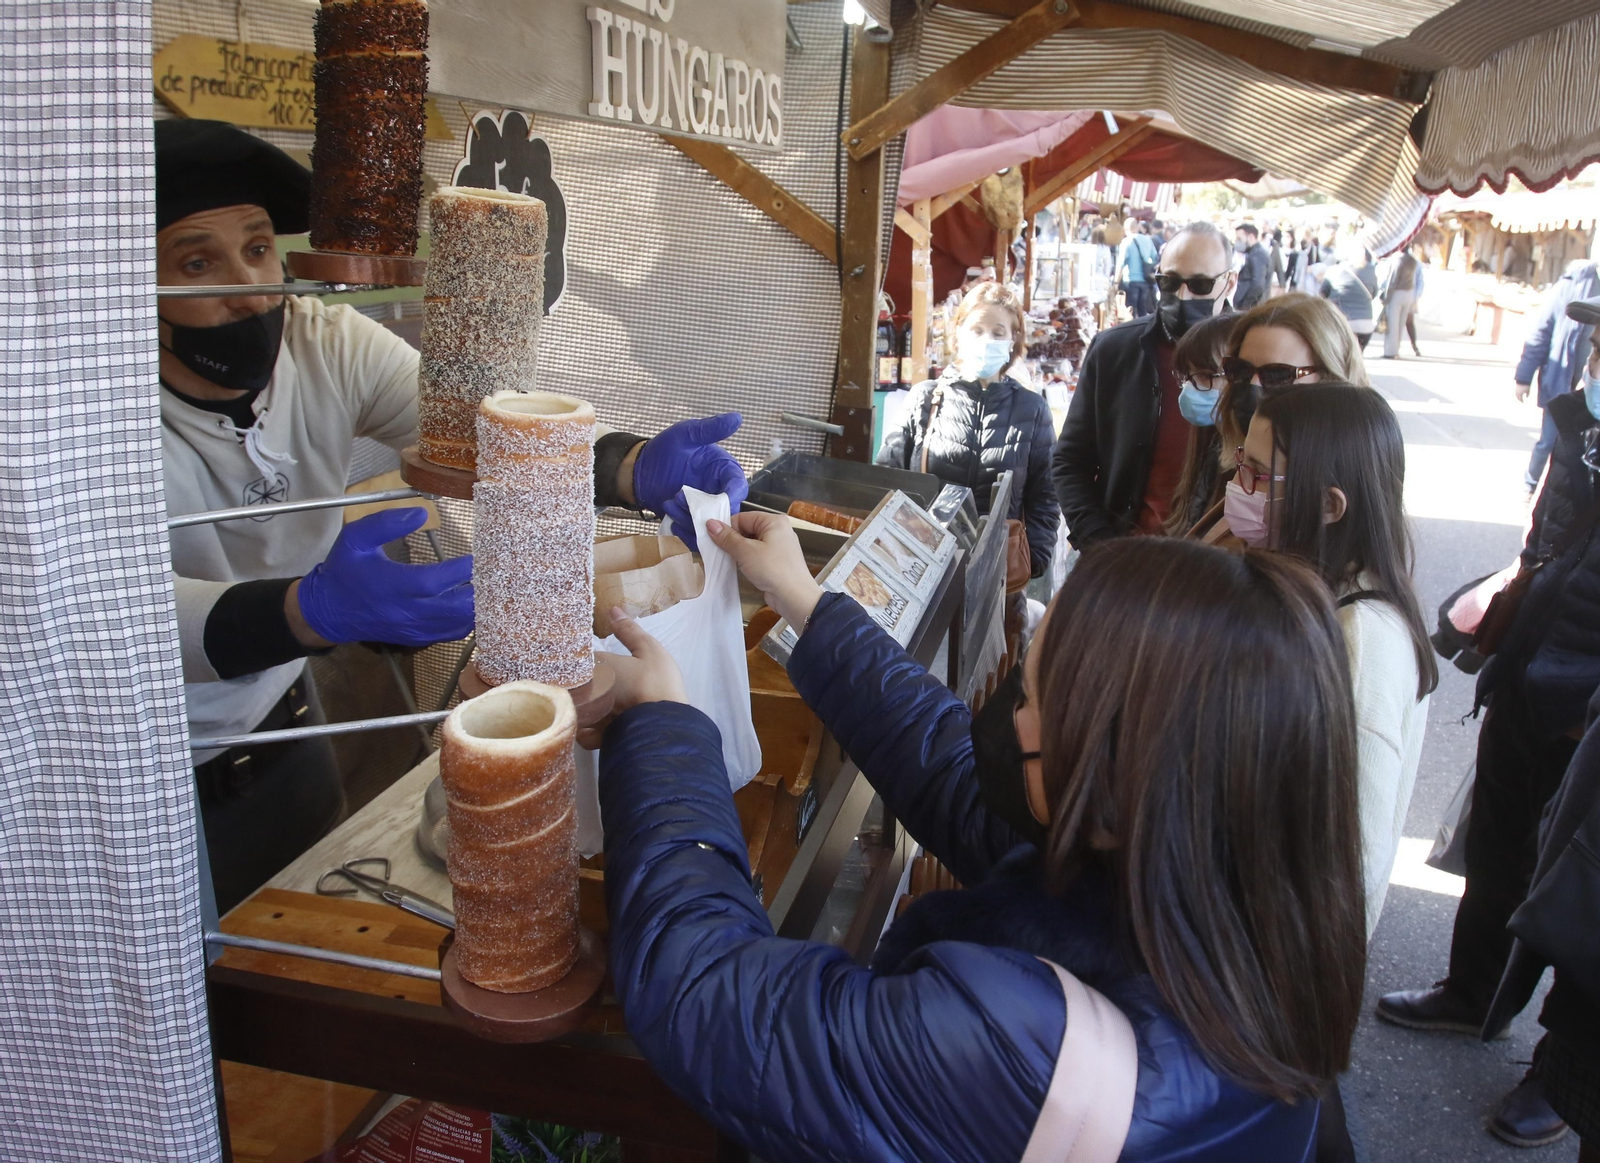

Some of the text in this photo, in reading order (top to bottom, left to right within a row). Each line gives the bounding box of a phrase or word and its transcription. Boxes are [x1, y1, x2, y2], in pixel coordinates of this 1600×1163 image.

[161, 65, 185, 92] de
[587, 7, 782, 146] HUNGAROS
[195, 354, 229, 373] STAFF
[902, 561, 926, 587] Coco
[449, 1125, 471, 1136] DELICIAS
